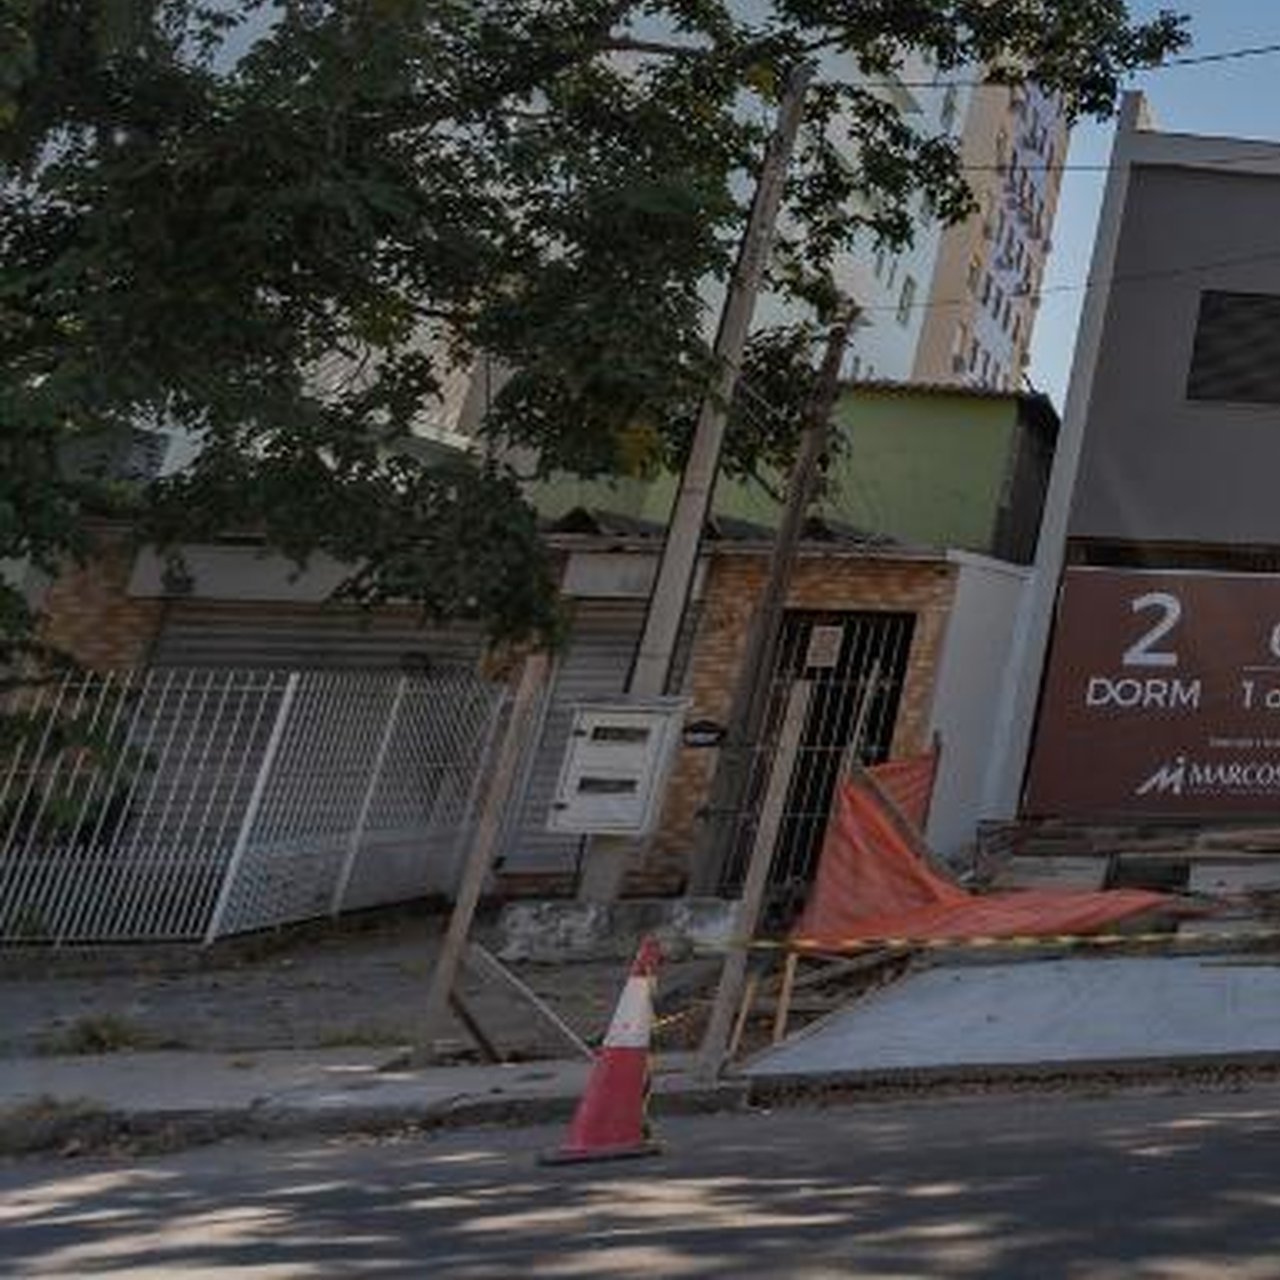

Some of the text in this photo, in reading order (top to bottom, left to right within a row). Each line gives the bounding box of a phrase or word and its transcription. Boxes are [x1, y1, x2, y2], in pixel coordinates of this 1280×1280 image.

[1122, 591, 1182, 667] 2
[1085, 676, 1201, 709] DORM
[1242, 680, 1254, 710] 1
